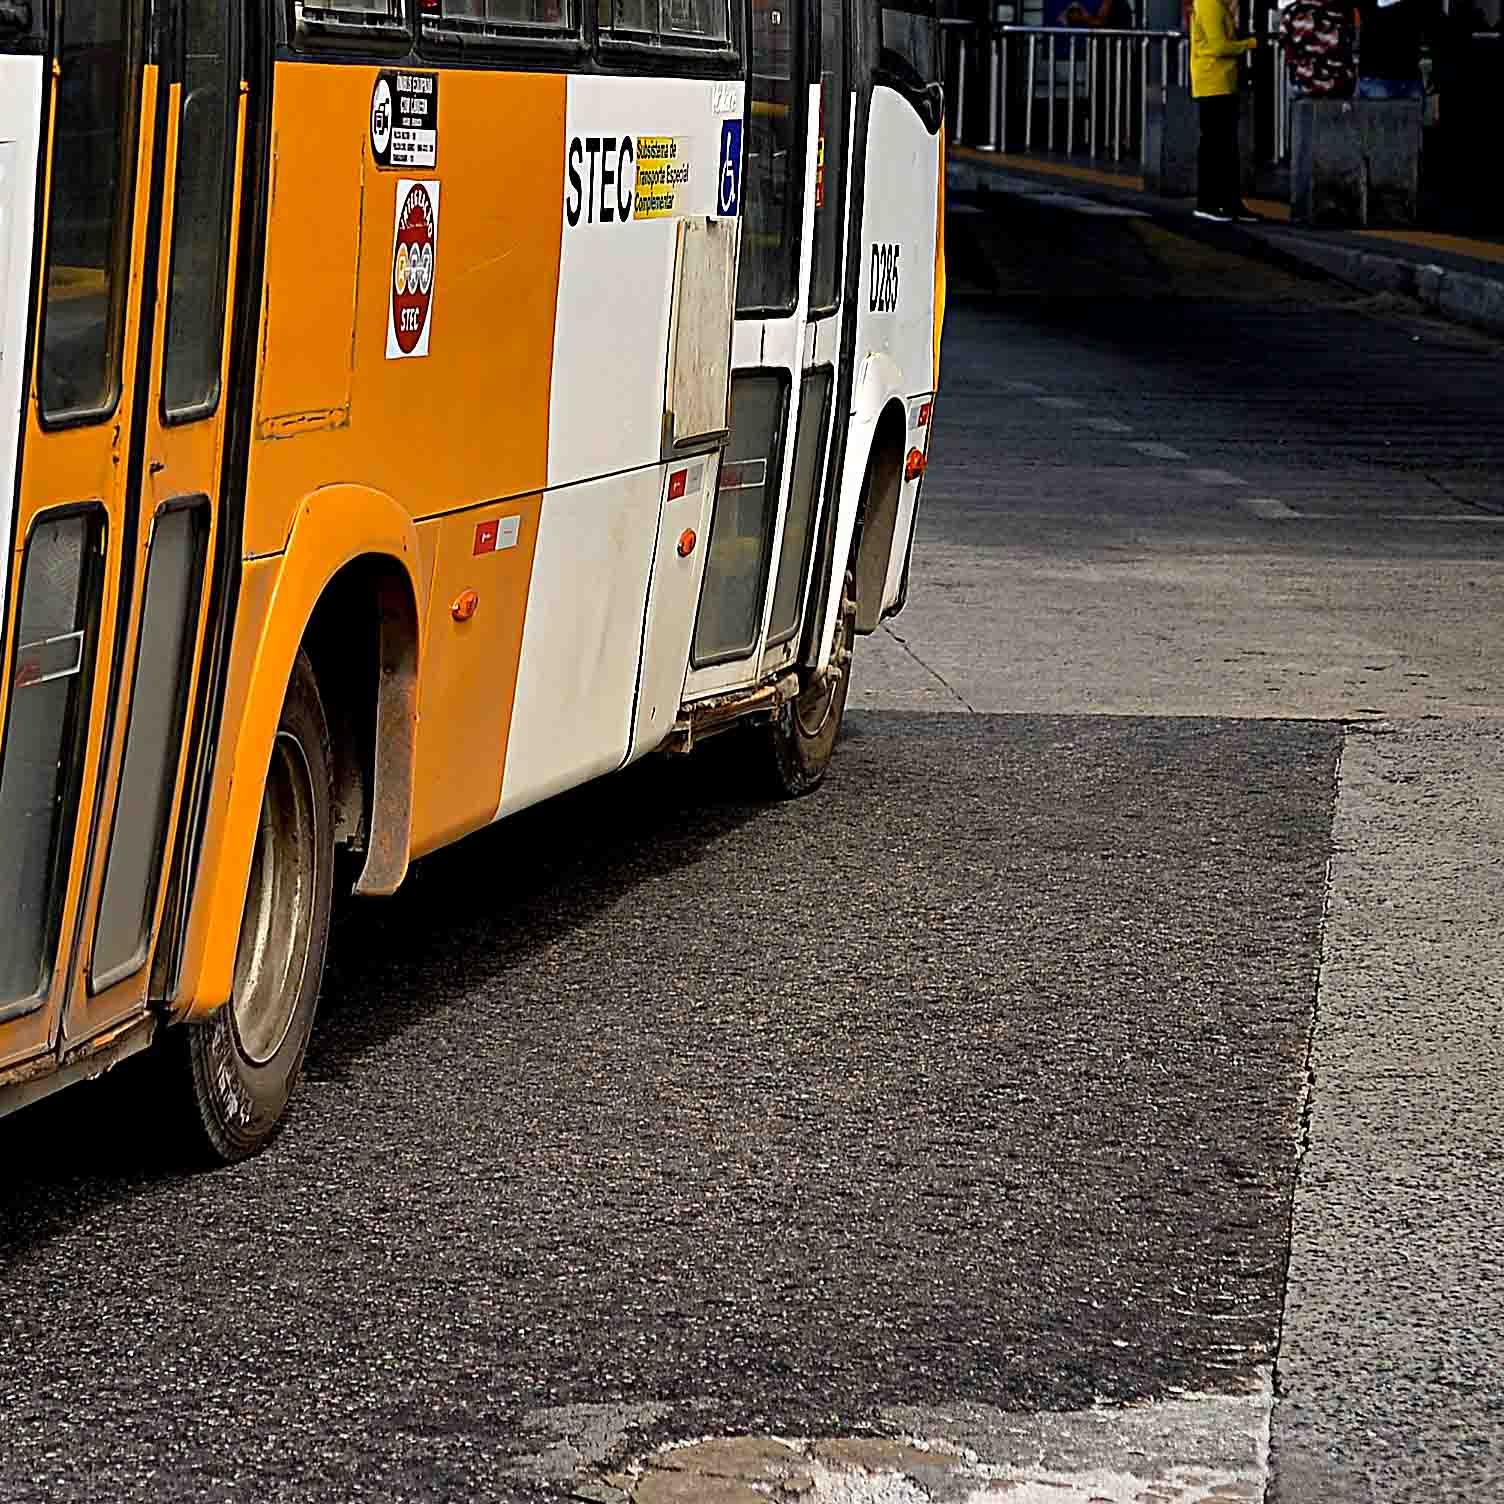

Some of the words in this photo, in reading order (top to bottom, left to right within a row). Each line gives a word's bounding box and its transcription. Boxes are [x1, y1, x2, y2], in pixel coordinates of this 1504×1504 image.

[566, 135, 634, 227] STEC
[869, 243, 900, 313] D285
[400, 307, 420, 332] STEC
